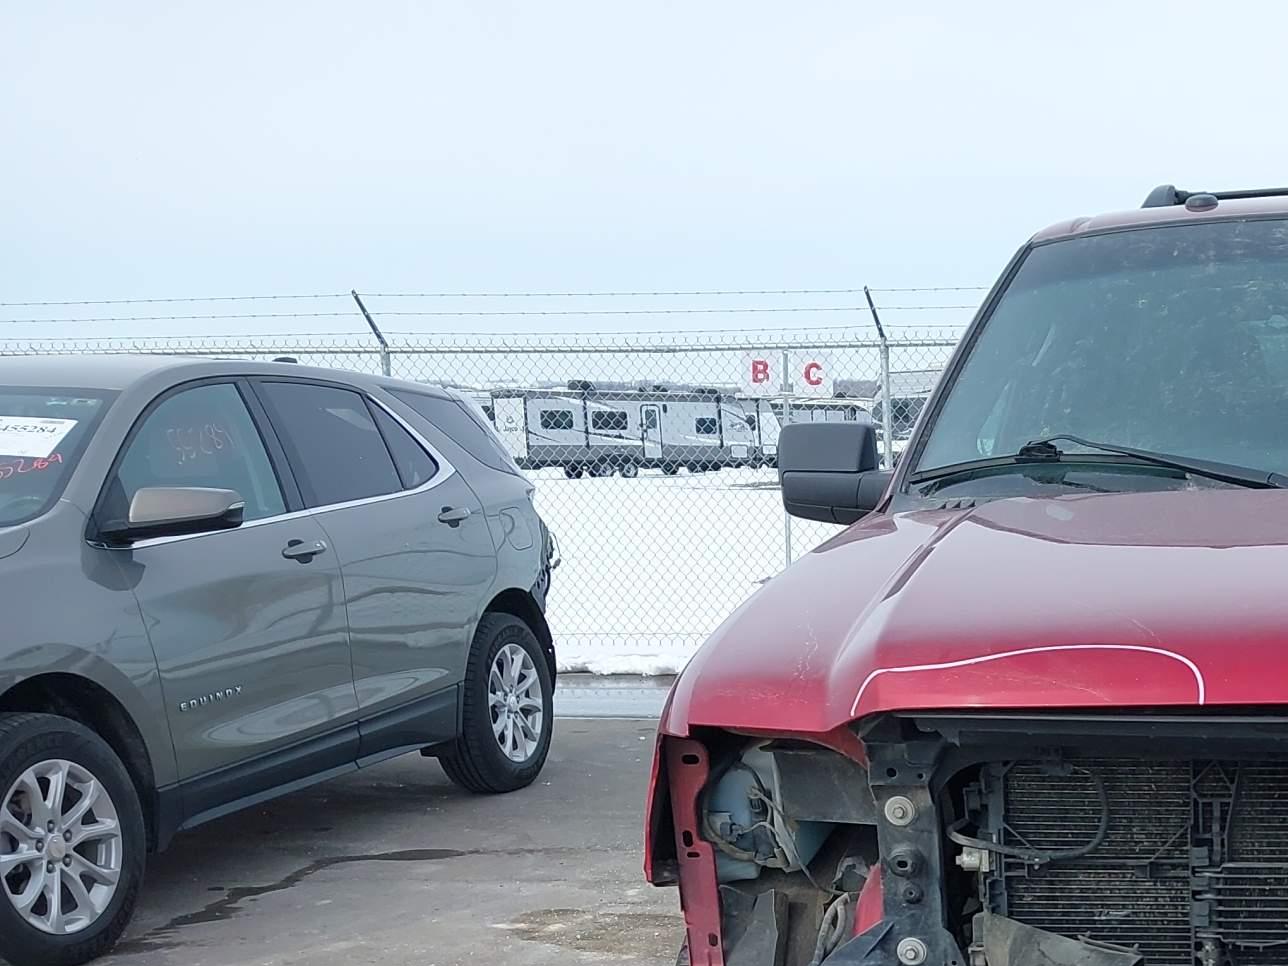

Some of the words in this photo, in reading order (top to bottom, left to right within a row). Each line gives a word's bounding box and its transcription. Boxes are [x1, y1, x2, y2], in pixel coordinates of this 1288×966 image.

[752, 360, 769, 383] B
[803, 362, 822, 385] C
[180, 685, 242, 712] EQUINOX
